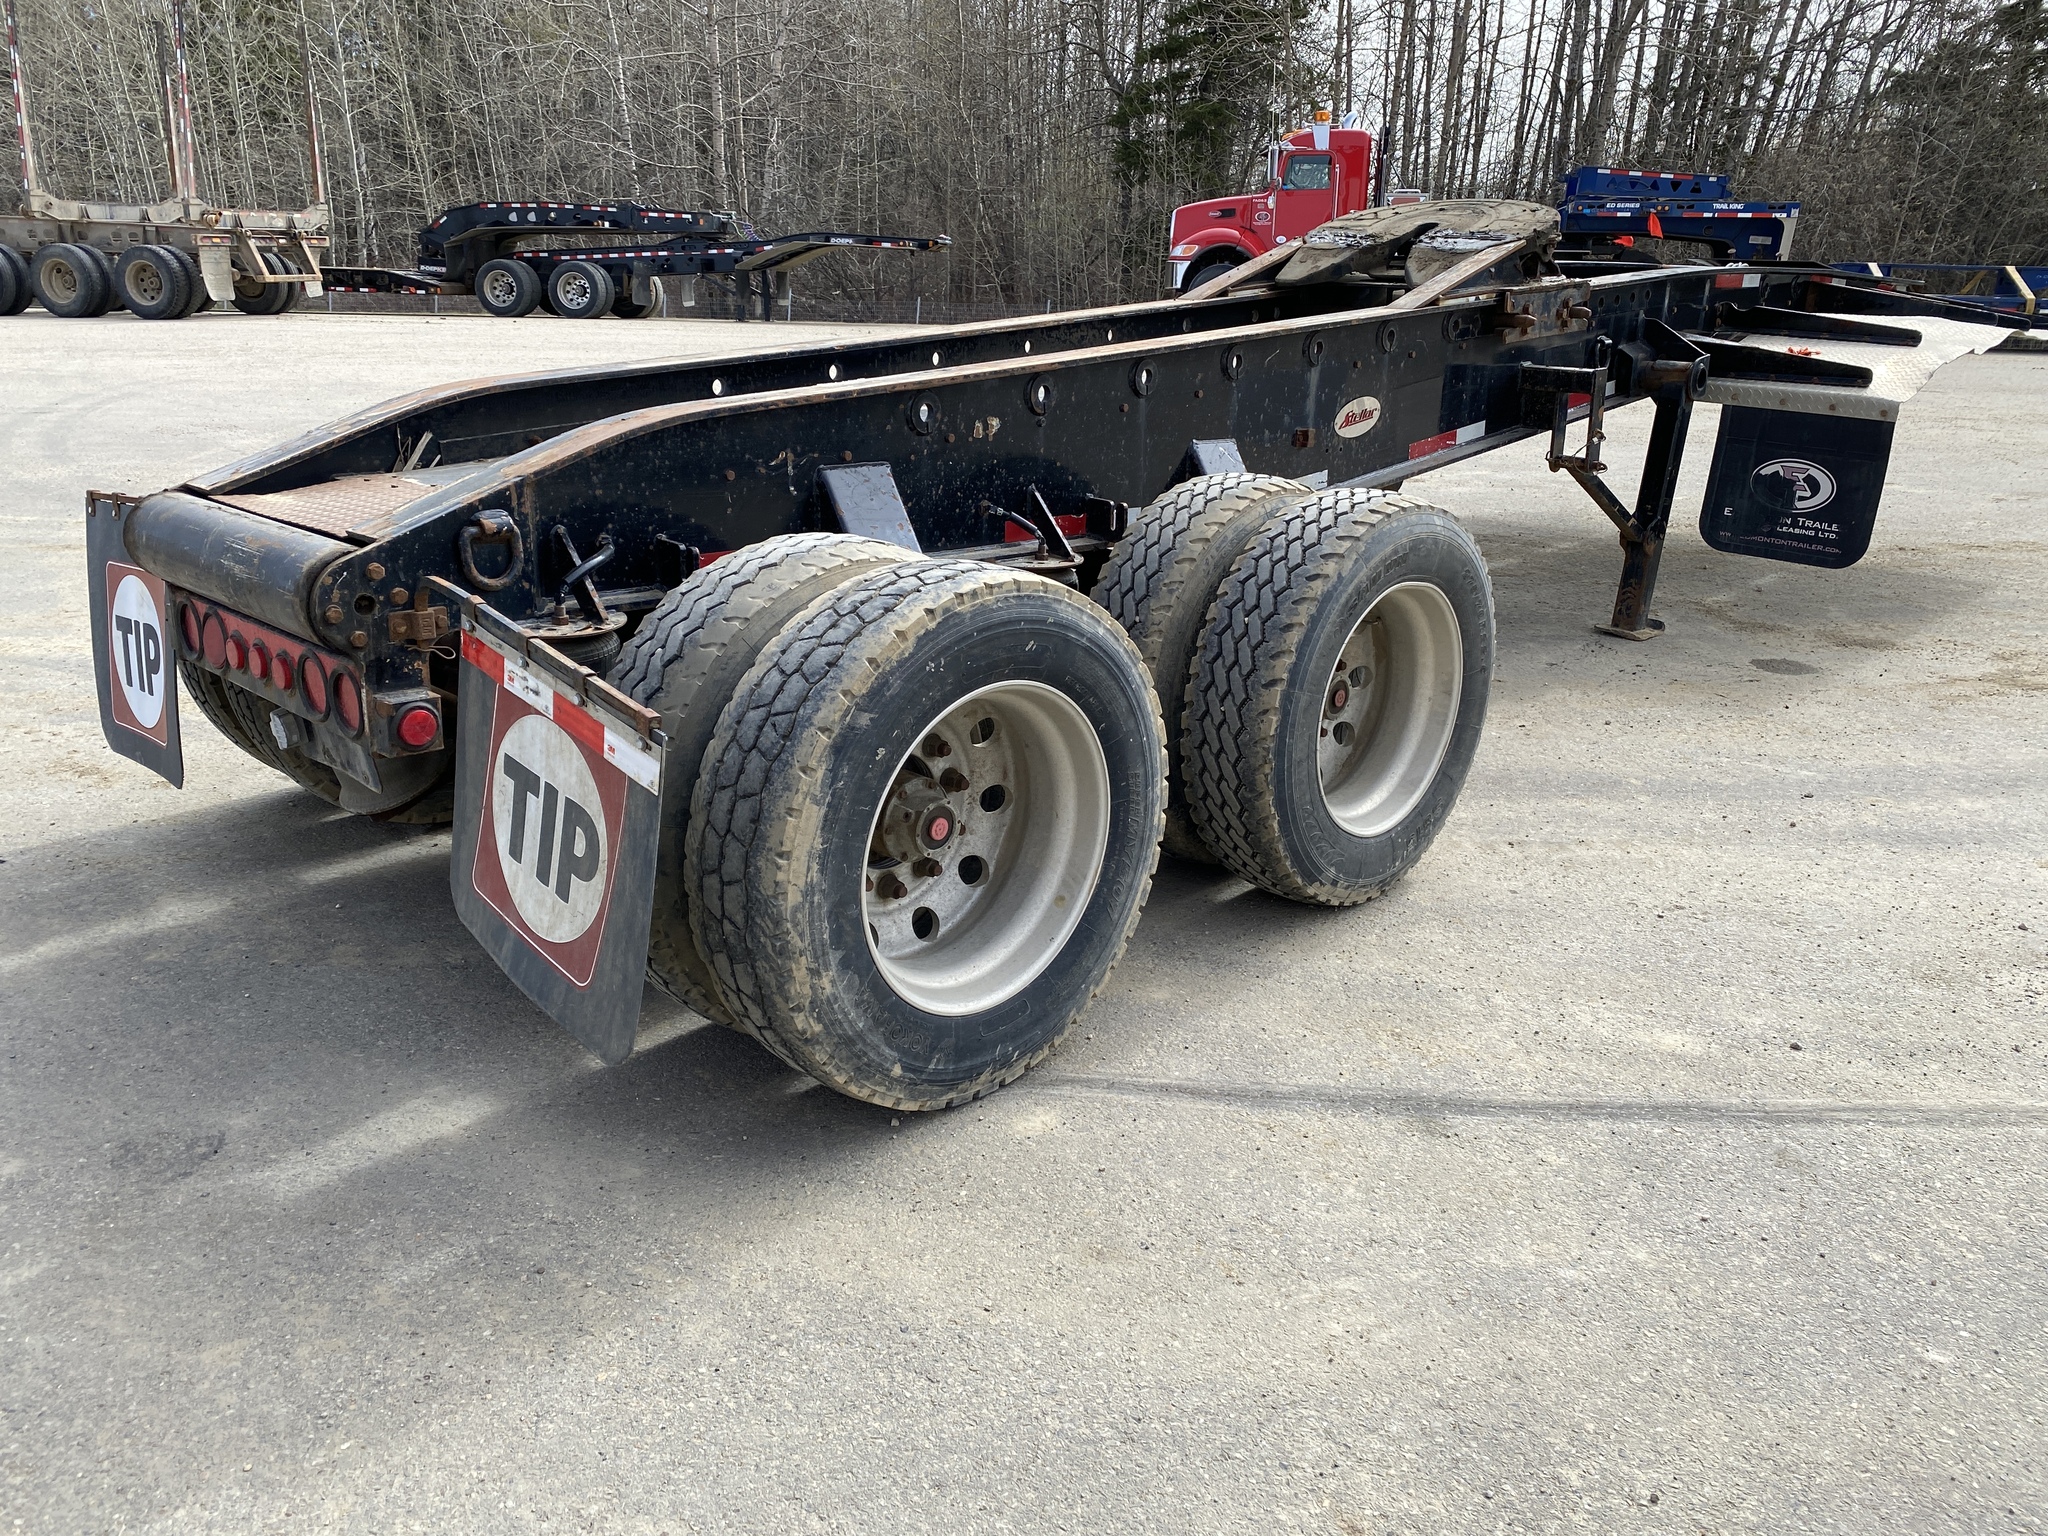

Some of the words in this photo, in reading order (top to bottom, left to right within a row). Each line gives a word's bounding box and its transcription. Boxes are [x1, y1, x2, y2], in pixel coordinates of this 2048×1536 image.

[1776, 526, 1815, 537] LEASING
[1818, 531, 1839, 540] LTD.
[1797, 517, 1839, 532] TRAILE
[115, 614, 161, 697] TIP
[503, 752, 599, 904] TIP
